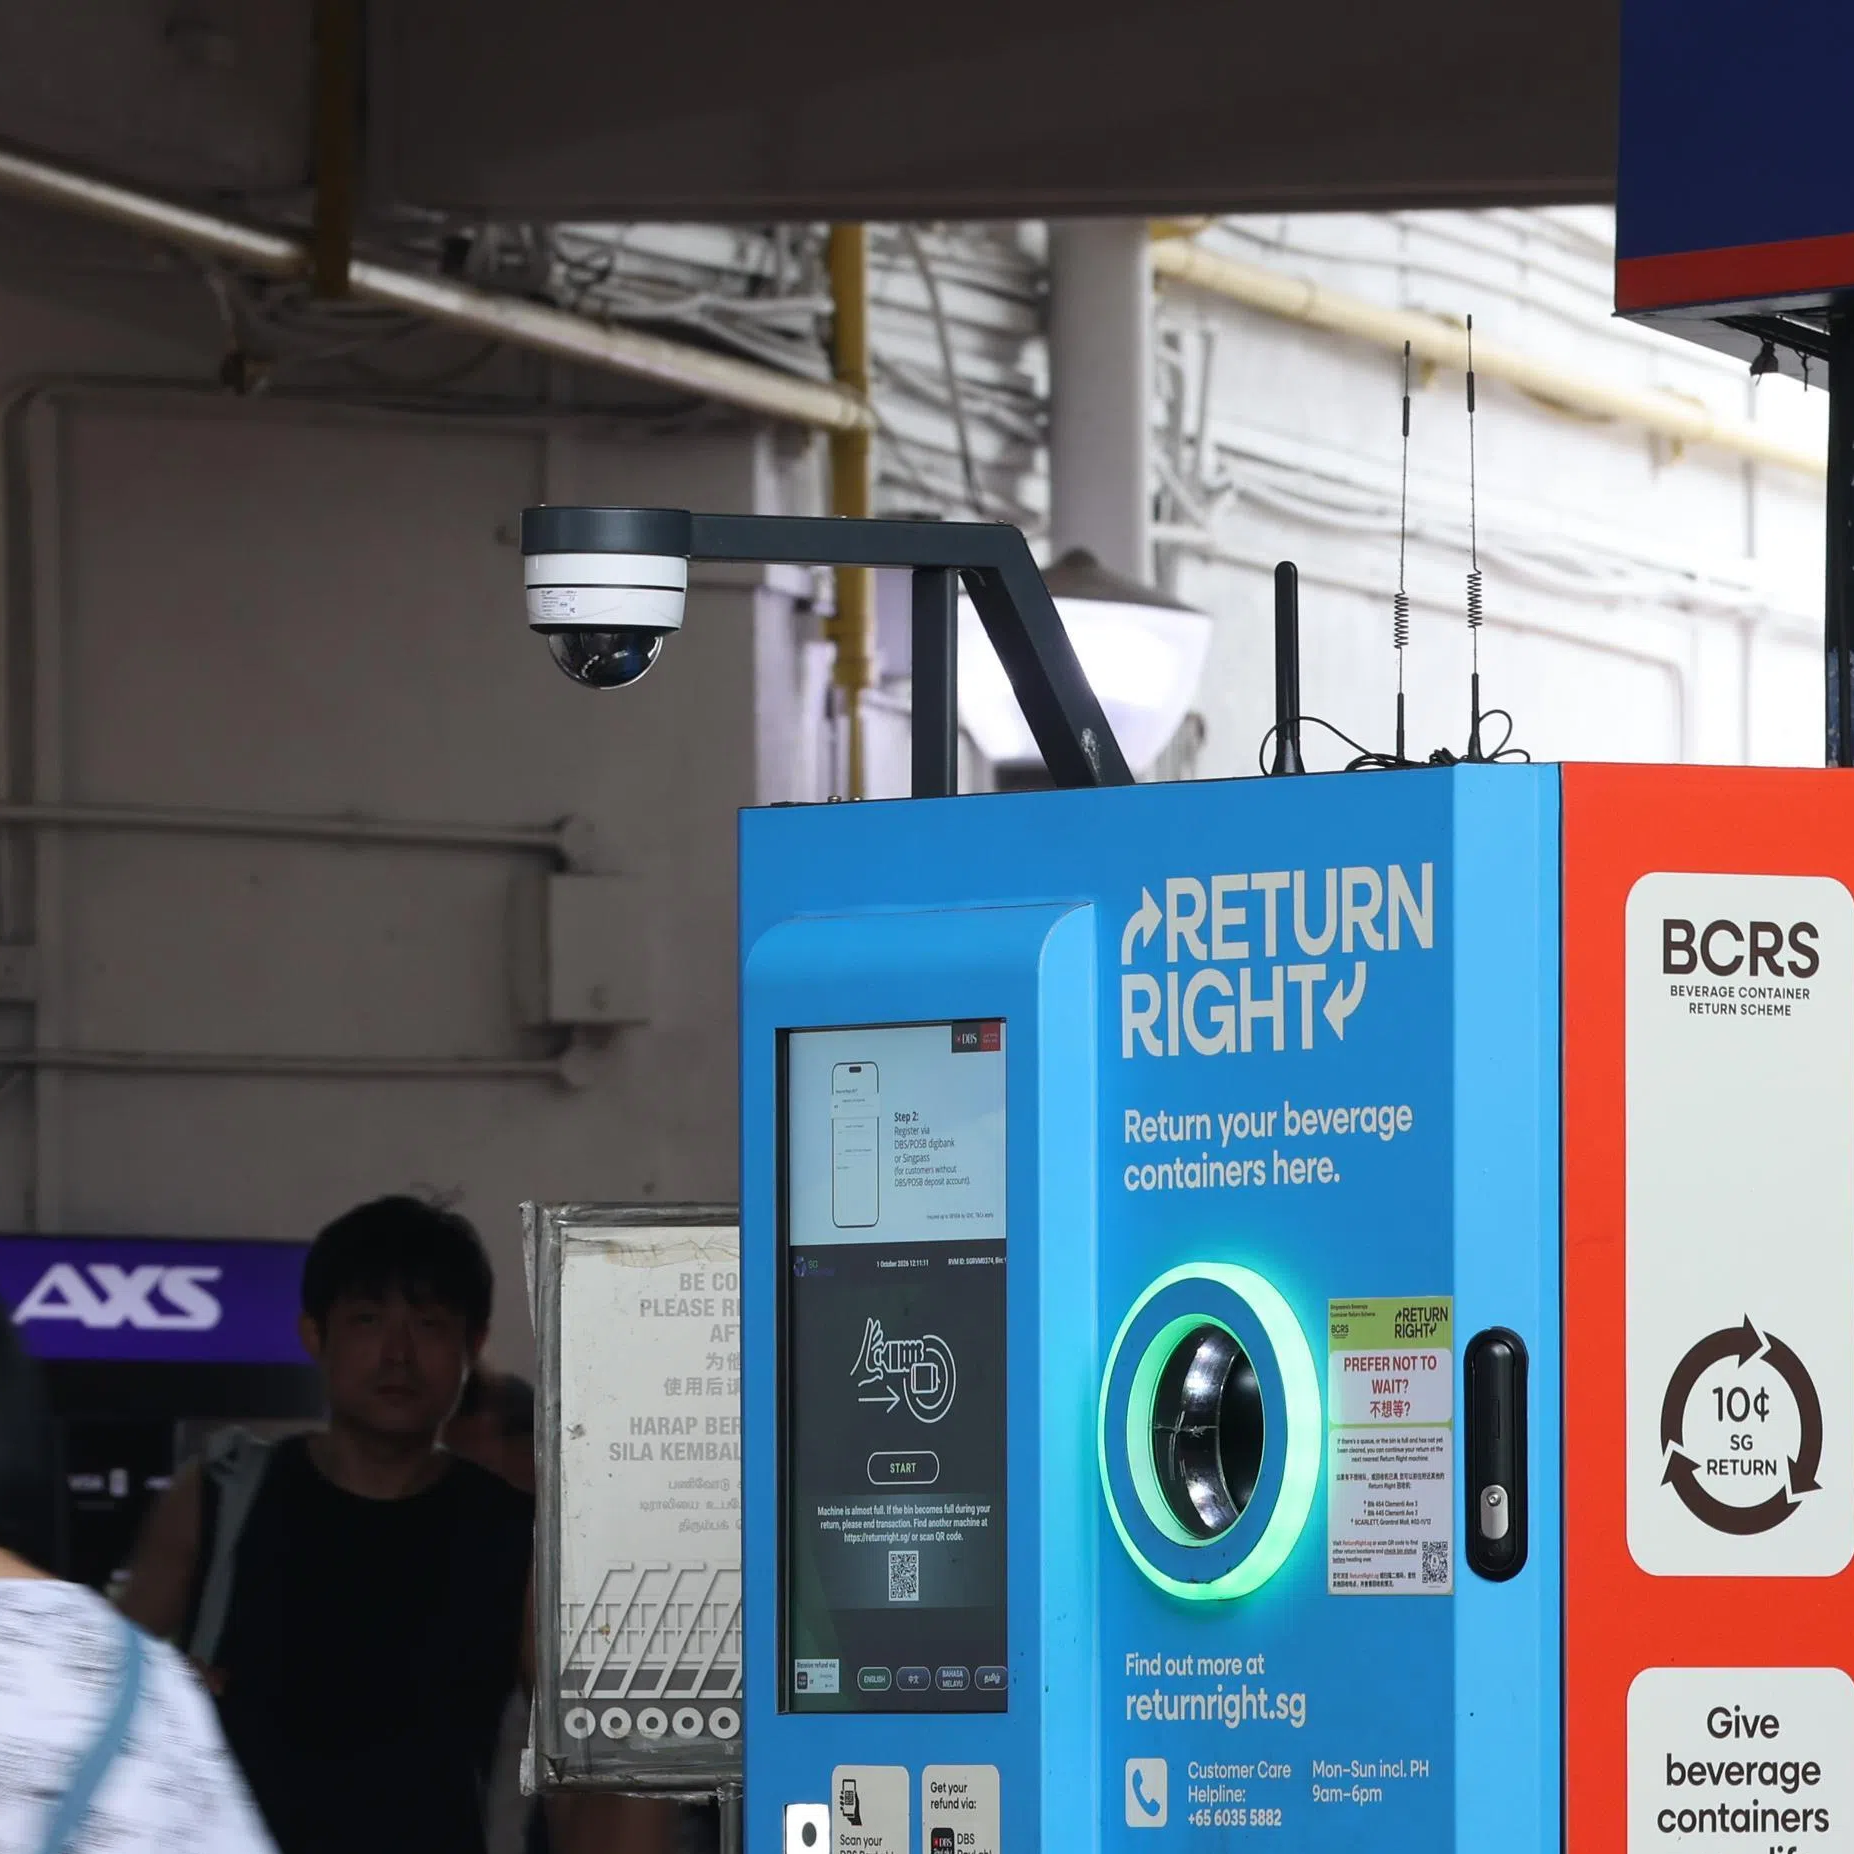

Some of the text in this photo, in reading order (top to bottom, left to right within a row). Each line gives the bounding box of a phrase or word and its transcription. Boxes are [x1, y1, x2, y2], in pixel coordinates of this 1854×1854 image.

[1166, 862, 1433, 962] RETURN
[1663, 919, 1819, 978] BCRS
[1671, 985, 1809, 999] BEVERAGE CONTAINER
[1122, 965, 1325, 1058] RIGHT
[1690, 1003, 1791, 1016] RETURN SCHEME
[894, 1112, 918, 1122] Step 2:
[1125, 1101, 1412, 1148] Return your beverage
[1124, 1150, 1339, 1191] containers here.
[680, 1273, 704, 1291] BE
[13, 1264, 221, 1330] AXS
[640, 1299, 714, 1317] PLEASE
[1344, 1356, 1437, 1372] PREFER NOT TO
[1372, 1379, 1408, 1394] WAIT?
[1713, 1387, 1769, 1422] 10¢
[630, 1417, 697, 1435] HARAP
[1730, 1434, 1753, 1450] SG
[610, 1442, 653, 1461] SILA
[890, 1463, 916, 1473] START
[1707, 1459, 1776, 1475] RETURN
[1707, 1705, 1779, 1738] Give
[1188, 1761, 1291, 1779] Customer Care
[1380, 1760, 1406, 1777] incl.
[1411, 1761, 1429, 1777] PH
[1667, 1753, 1821, 1794] beverage
[1189, 1786, 1245, 1805] Helpline:
[1188, 1809, 1281, 1826] +65 6035 5882
[1658, 1799, 1829, 1833] containers
[840, 1835, 882, 1848] Scan your
